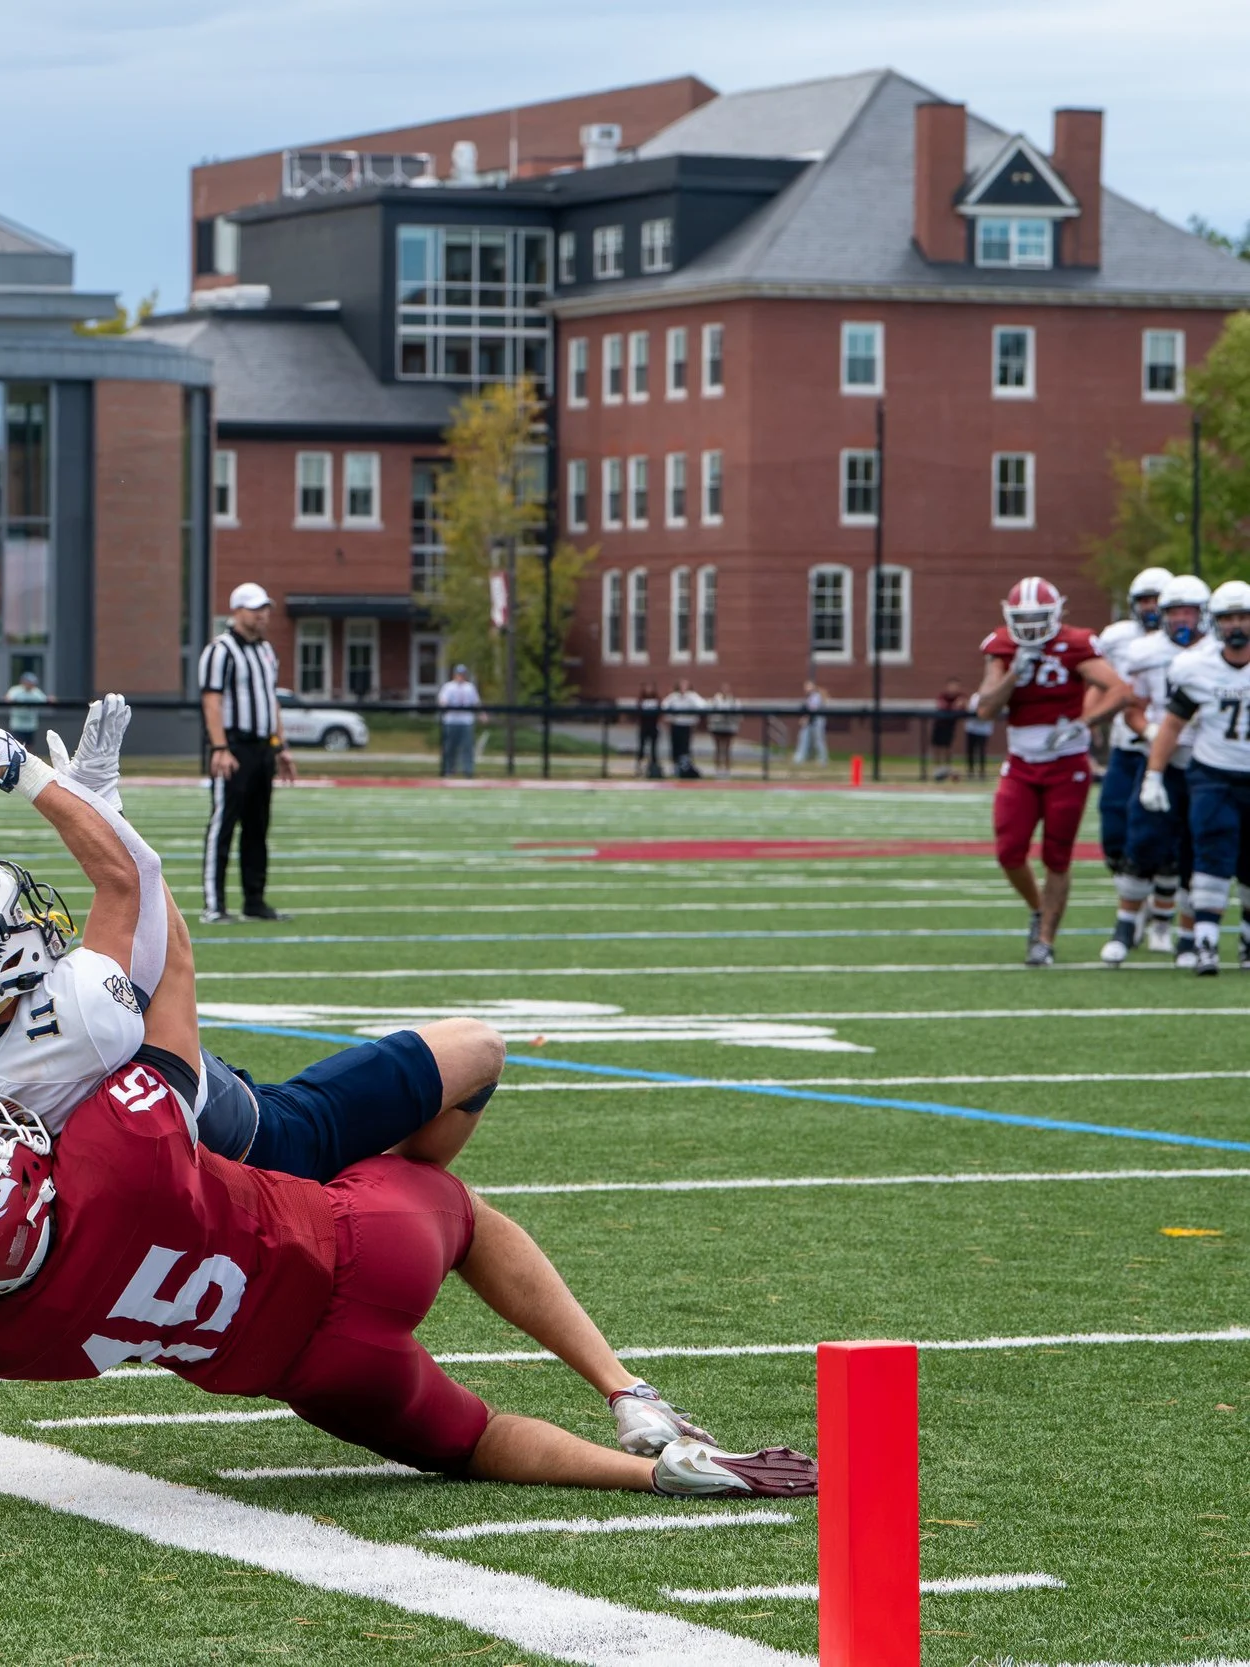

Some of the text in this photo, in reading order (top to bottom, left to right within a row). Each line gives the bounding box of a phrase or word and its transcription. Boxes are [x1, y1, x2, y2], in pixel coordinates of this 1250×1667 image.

[26, 996, 62, 1044] 11
[109, 1066, 169, 1113] 15
[81, 1244, 248, 1375] 15
